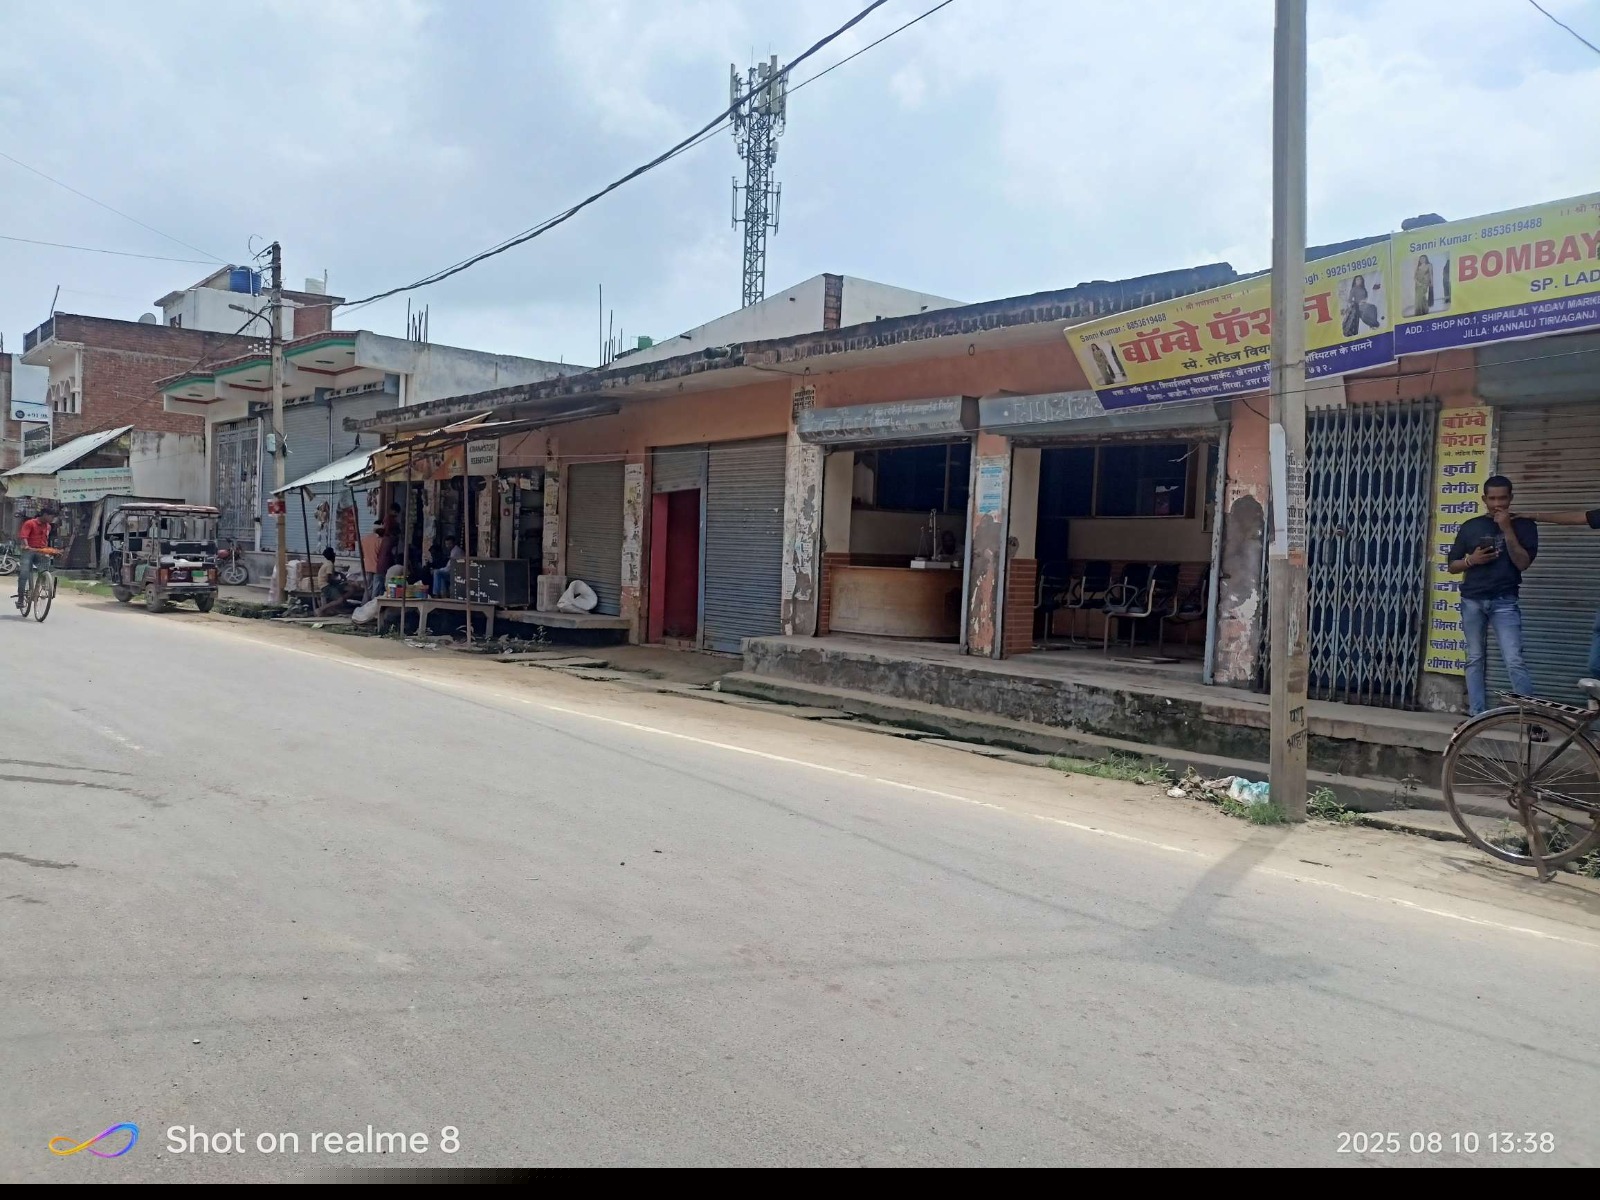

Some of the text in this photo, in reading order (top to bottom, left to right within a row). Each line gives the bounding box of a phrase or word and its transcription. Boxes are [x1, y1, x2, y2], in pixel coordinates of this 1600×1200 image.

[1409, 238, 1437, 253] Sanni
[1439, 233, 1472, 248] Kumar
[1480, 217, 1543, 239] 8853619488
[1458, 229, 1600, 283] BOMBAY
[1326, 256, 1378, 278] 9926198902
[1530, 278, 1558, 293] SP.
[1431, 320, 1456, 331] SHOP
[1481, 308, 1529, 323] SHIPAILAL
[1532, 301, 1564, 315] YADAV
[1079, 332, 1099, 343] Sanni
[1099, 326, 1121, 338] Kumar
[1463, 327, 1491, 339] JILLA:
[1492, 319, 1537, 334] KANNAUJ
[1119, 319, 1203, 365] बॉम्बे
[1339, 345, 1348, 355] के
[1350, 339, 1373, 353] सामने
[1441, 411, 1488, 429] बॉम्बे
